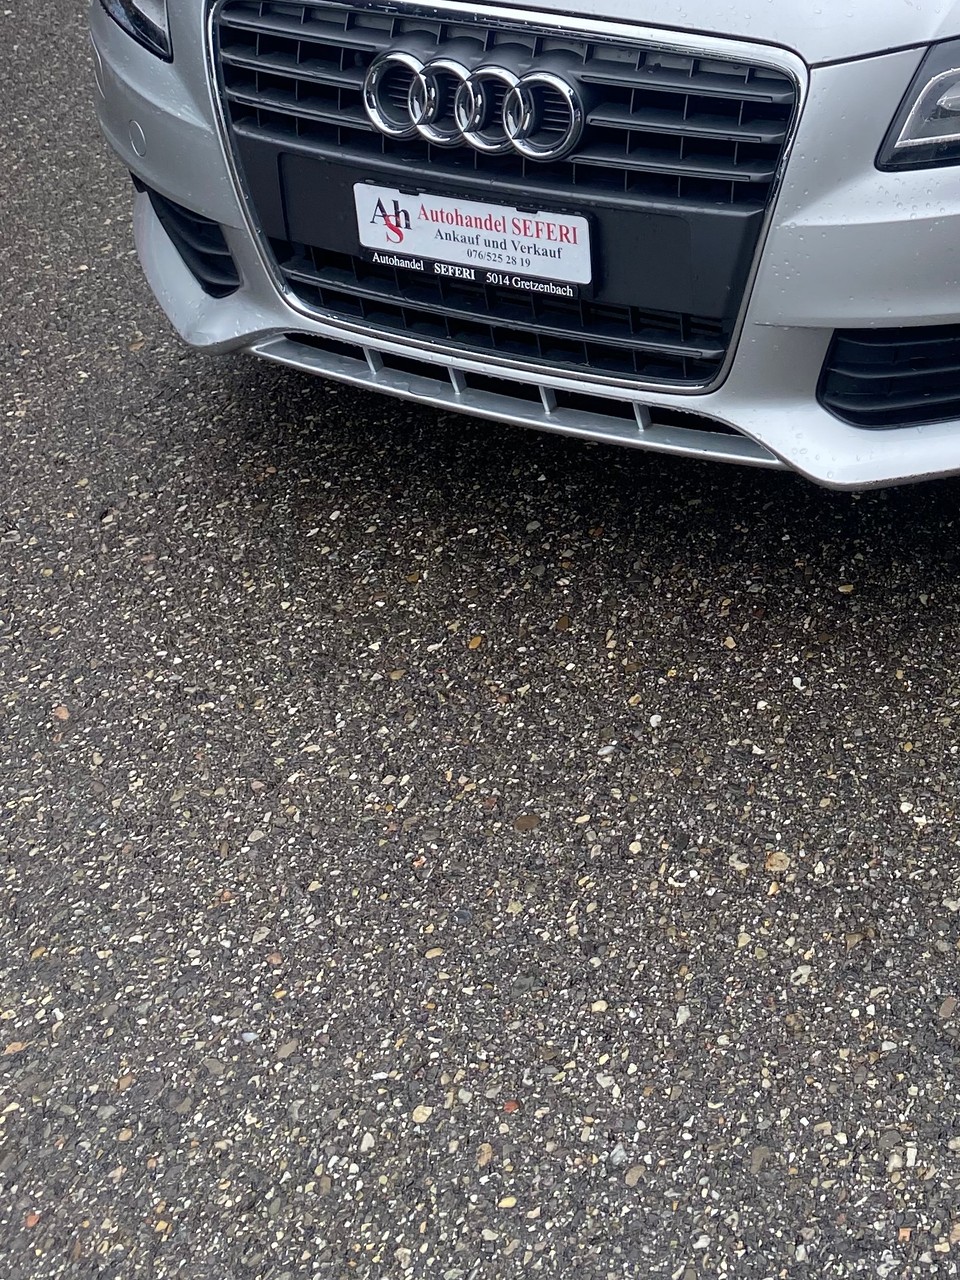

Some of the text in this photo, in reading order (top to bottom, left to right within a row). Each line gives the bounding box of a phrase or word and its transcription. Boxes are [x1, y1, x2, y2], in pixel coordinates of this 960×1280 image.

[418, 203, 579, 245] Autohandel SEFERI
[434, 228, 563, 259] Ankauf und Verkauf
[467, 248, 531, 267] 076/525 28 19
[372, 252, 573, 297] Autohandel SEFERI 5014 Gretzenbach
